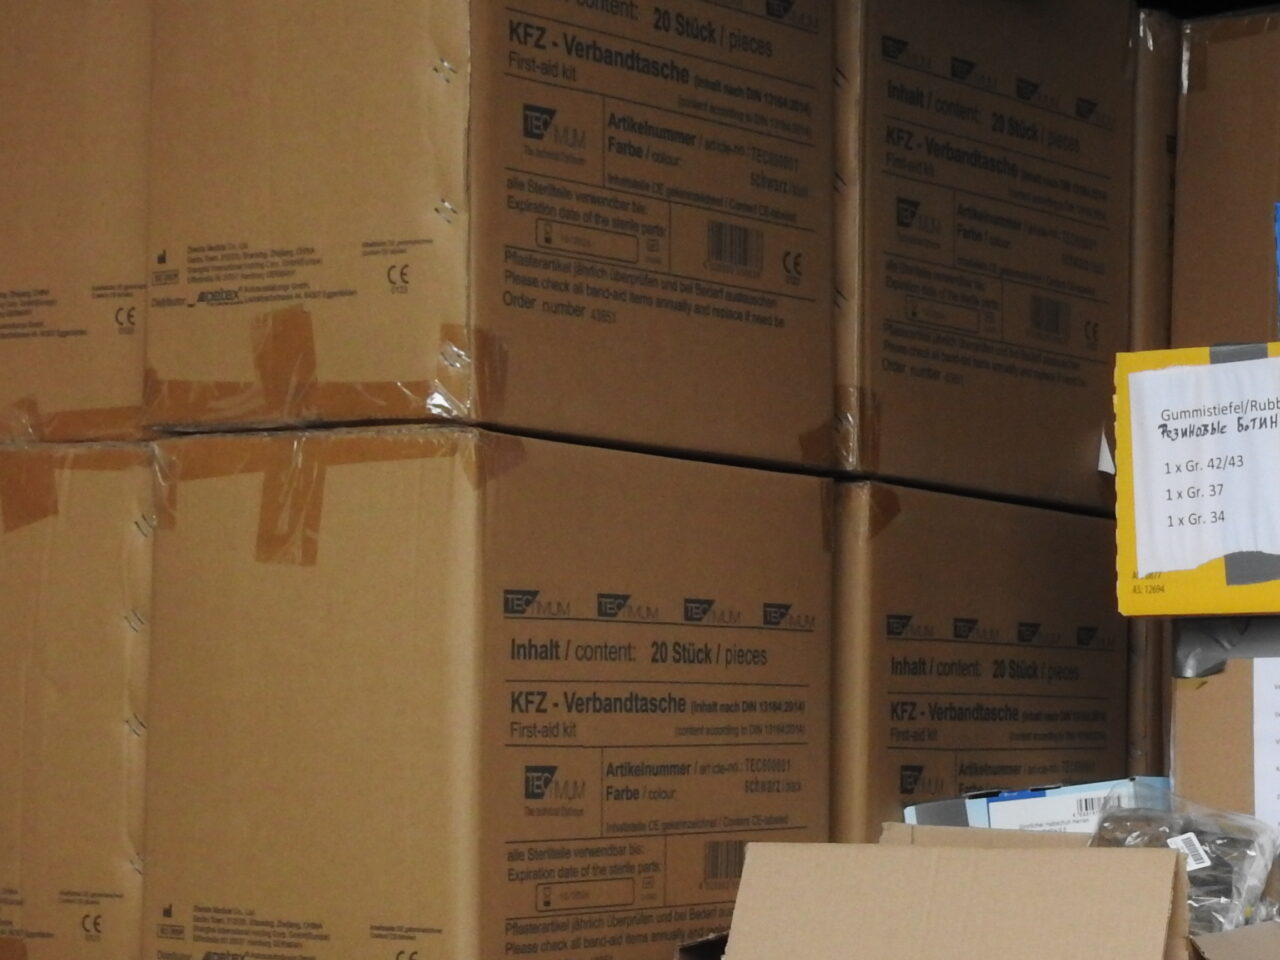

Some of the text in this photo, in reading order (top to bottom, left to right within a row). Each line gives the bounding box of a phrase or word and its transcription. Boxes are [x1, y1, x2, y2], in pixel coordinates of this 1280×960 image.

[653, 7, 773, 58] 20 Stück pieces
[508, 19, 547, 50] KFZ
[562, 31, 690, 84] Verbandtasche
[508, 50, 577, 82] First-aid kit
[607, 112, 697, 147] Artikelnummer
[607, 136, 643, 160] Farbe
[885, 125, 1019, 179] KFZ Verbandtasche
[502, 290, 586, 319] Order number
[1165, 455, 1244, 474] 1 x Gr. 42/43
[1166, 484, 1224, 501] 1 x Gr. 37
[1168, 510, 1225, 527] 1 x Gr. 34
[510, 638, 562, 661] Inhalt
[574, 643, 636, 663] content:
[651, 641, 668, 664] 20
[672, 641, 713, 665] Stück
[725, 645, 768, 669] pieces
[890, 656, 927, 676] Inhalt
[992, 659, 1006, 678] 20
[1008, 659, 1038, 678] Stück
[510, 691, 548, 714] KFZ
[563, 691, 687, 714] Verbandtasche
[890, 702, 1019, 721] KFZ Verbandtasche
[509, 721, 561, 739] First-aid
[563, 721, 577, 738] kit
[606, 760, 692, 777] Artikelnummer
[606, 785, 640, 801] Farbe
[507, 867, 556, 884] Expiration
[557, 865, 579, 880] date
[580, 864, 591, 878] of
[592, 863, 608, 877] the
[655, 910, 672, 924] und
[505, 941, 540, 957] Please
[541, 938, 569, 954] check
